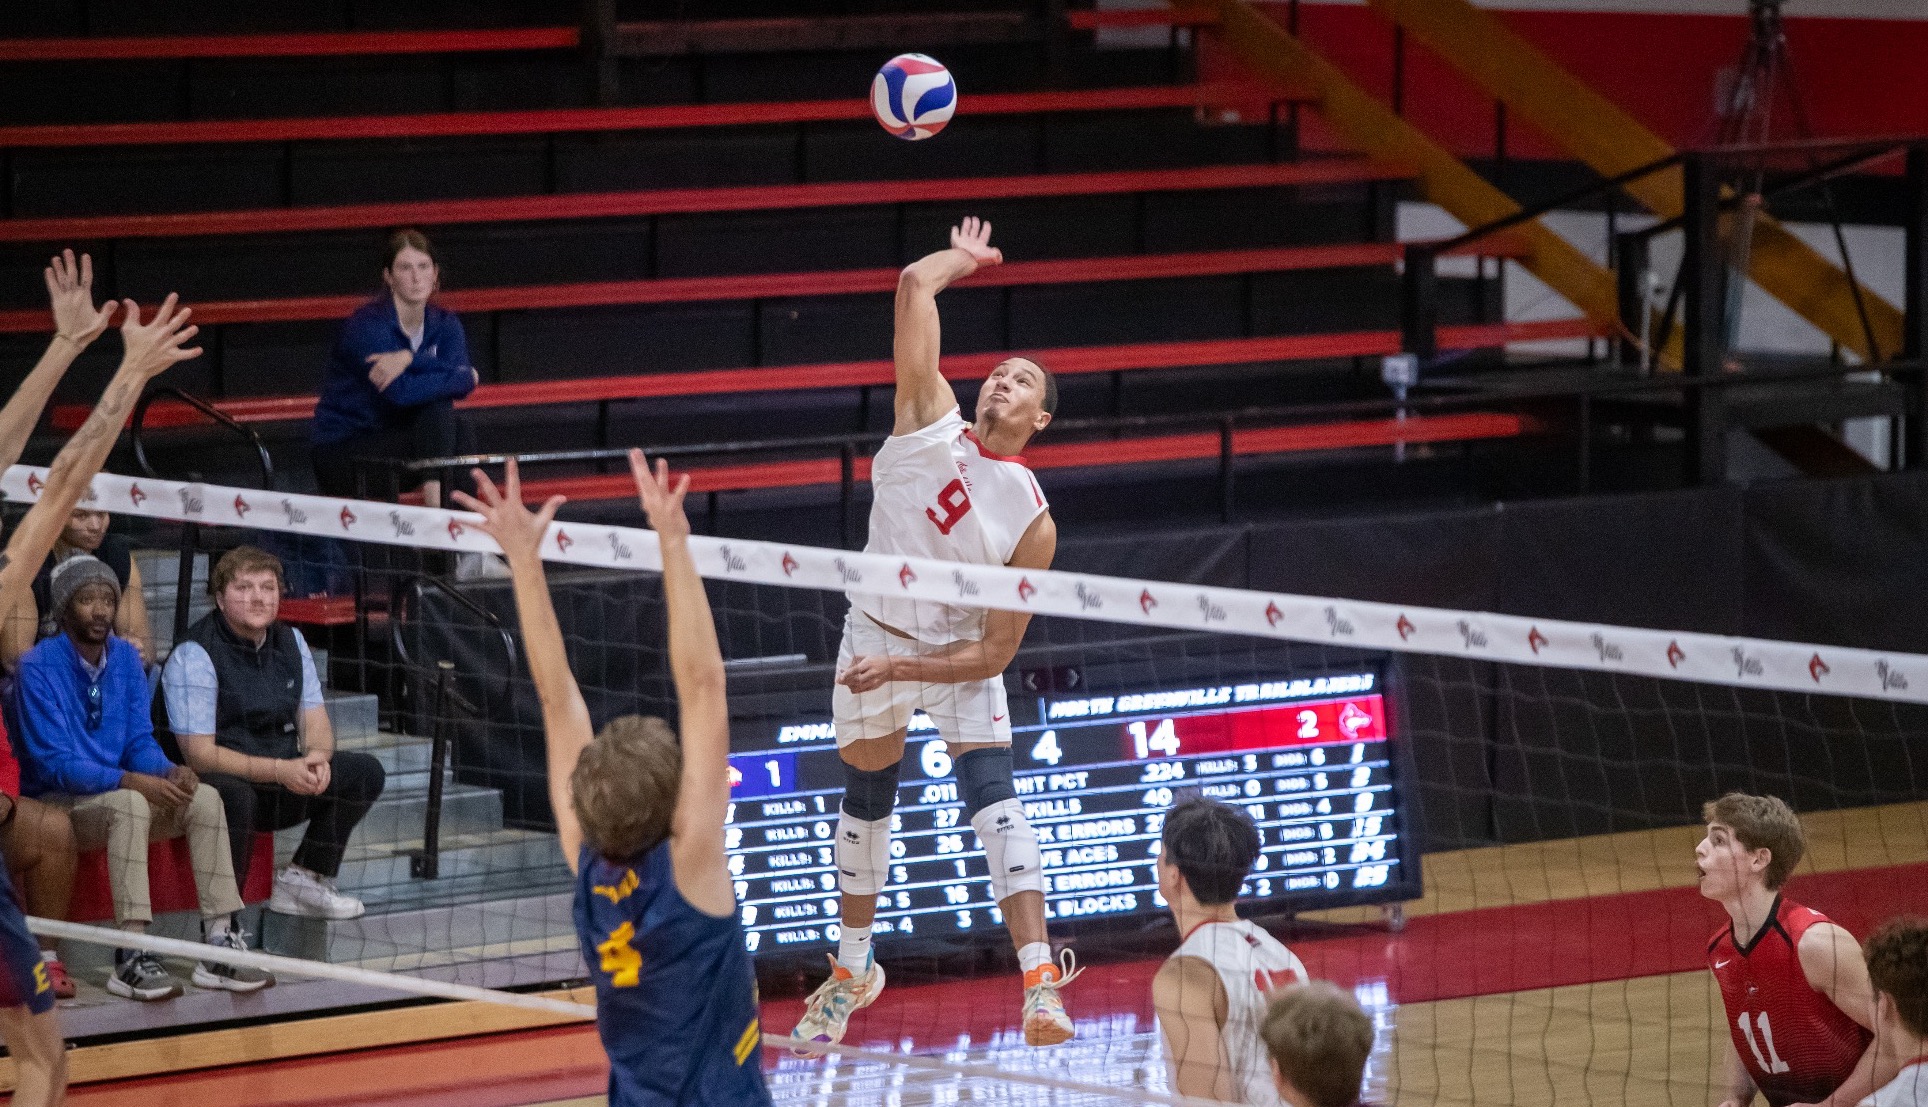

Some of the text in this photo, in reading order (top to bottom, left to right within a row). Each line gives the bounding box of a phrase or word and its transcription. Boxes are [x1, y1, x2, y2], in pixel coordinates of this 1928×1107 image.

[926, 478, 972, 535] 9
[1048, 673, 1374, 719] NORTH GREENVILLE TRAILBLAZERS
[1296, 710, 1320, 738] 2
[1030, 730, 1062, 765] 4
[1127, 719, 1180, 759] 14
[920, 739, 953, 778] 6
[1195, 759, 1238, 775] KILLS:
[1310, 748, 1326, 766] 6
[765, 759, 781, 787] 1
[1013, 772, 1089, 794] HIT PCT
[1143, 787, 1172, 806] 40
[1202, 779, 1261, 797] KILLS: 0
[763, 795, 826, 816] KILLS: 1
[1024, 798, 1082, 819] KILLS
[1316, 798, 1331, 814] 4
[935, 808, 960, 828] 27
[765, 822, 831, 842] KILLS: 0
[1056, 817, 1136, 841] ERRORS
[890, 840, 906, 858] 0
[1065, 844, 1118, 866] ACES
[1322, 847, 1336, 864] 2
[768, 852, 813, 868] KILLS:
[953, 859, 967, 878] 1
[771, 878, 815, 893] KILLS:
[1055, 868, 1135, 892] ERRORS
[1256, 878, 1272, 896] 2
[774, 903, 818, 919] KILLS:
[1057, 893, 1138, 917] BLOCKS
[776, 924, 842, 944] KILLS: 0
[898, 915, 913, 934] 4
[32, 961, 51, 996] E
[1737, 1011, 1790, 1074] 11
